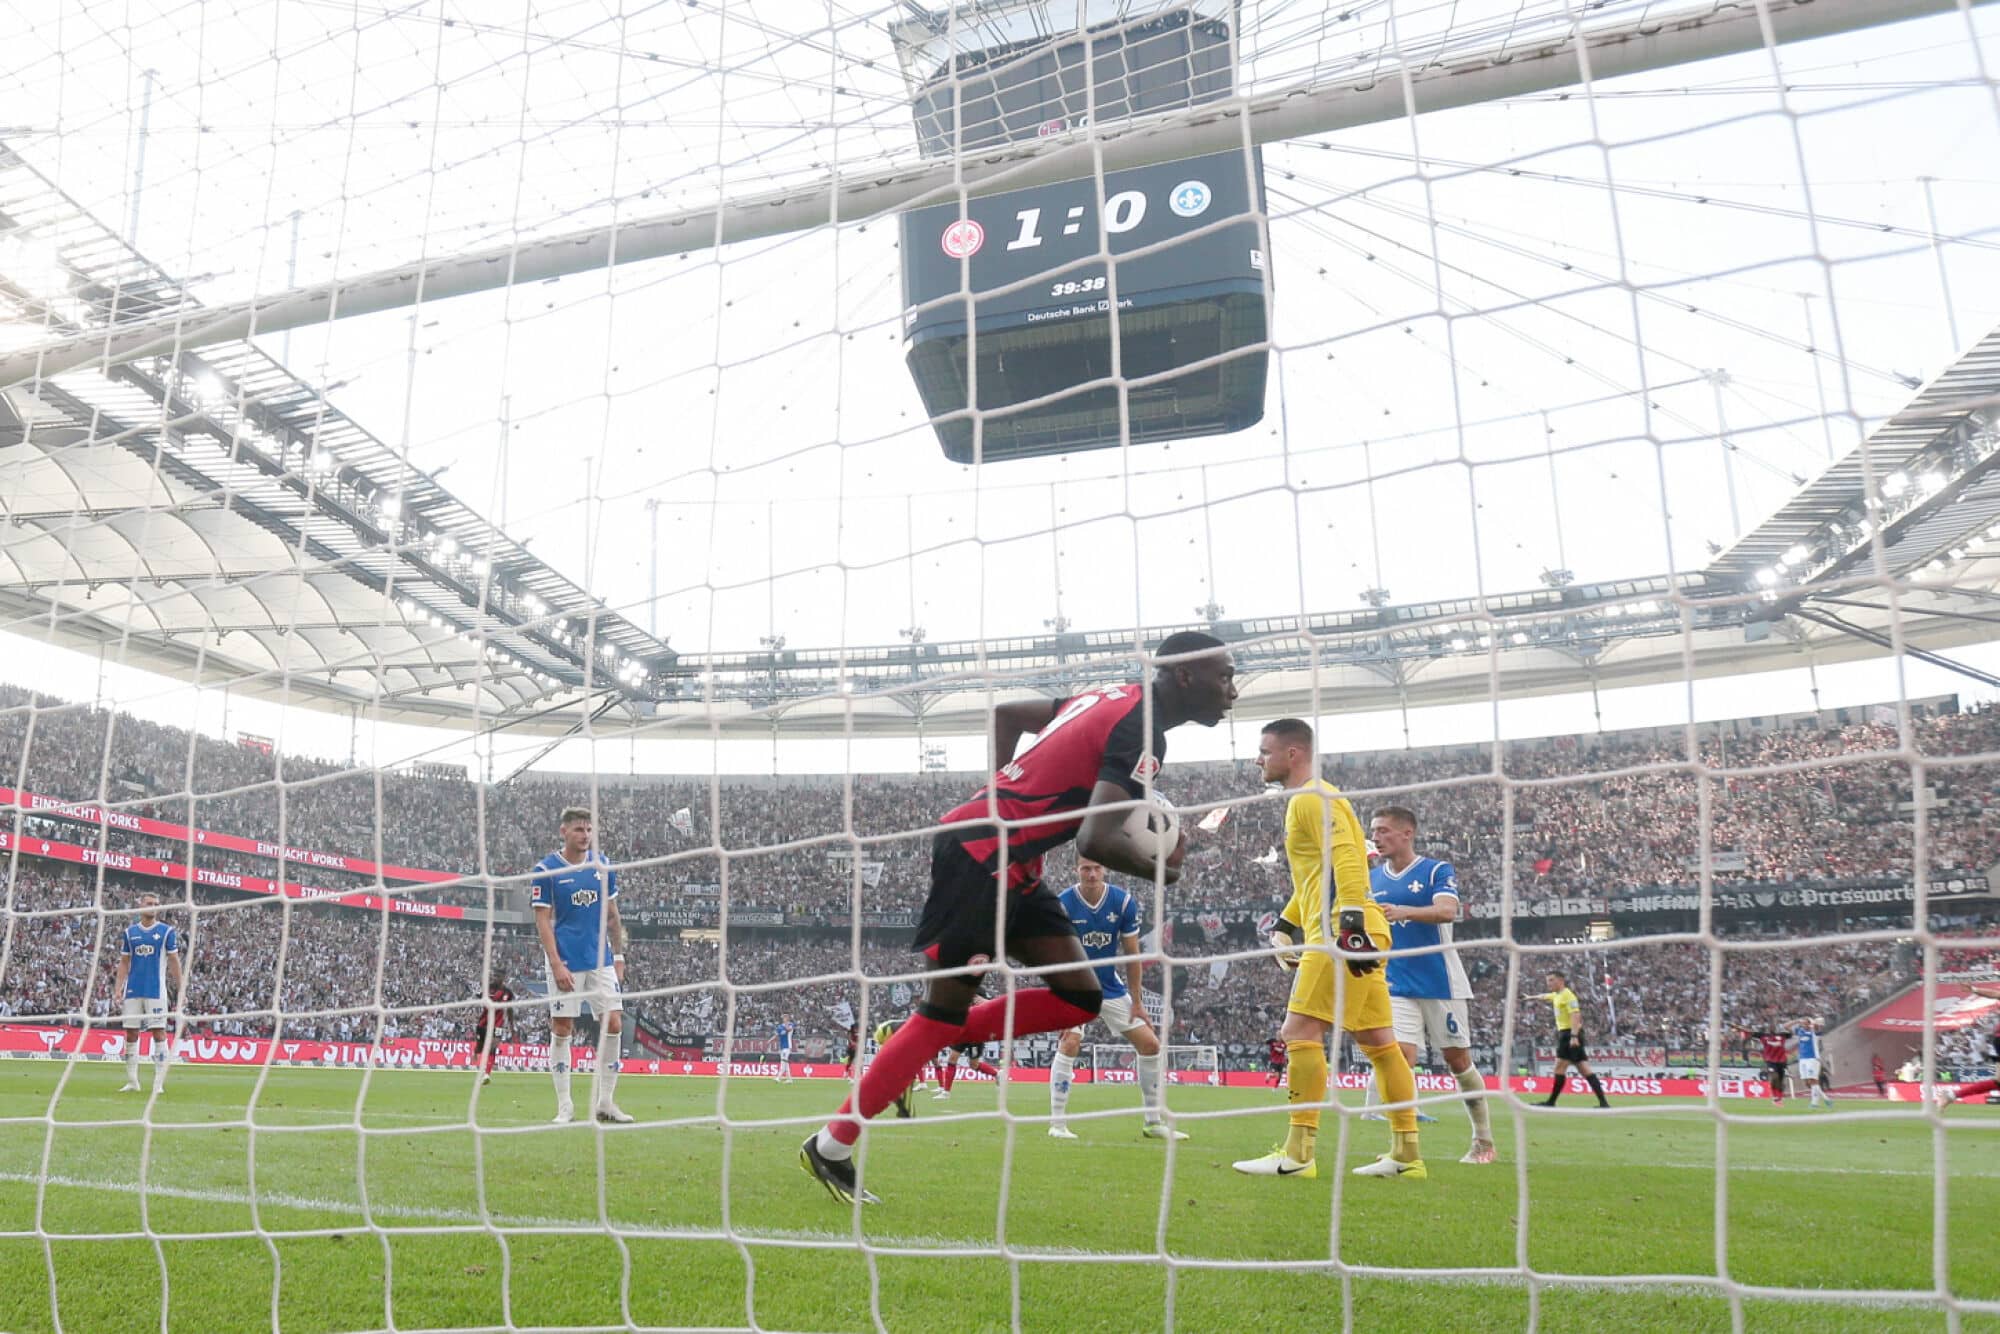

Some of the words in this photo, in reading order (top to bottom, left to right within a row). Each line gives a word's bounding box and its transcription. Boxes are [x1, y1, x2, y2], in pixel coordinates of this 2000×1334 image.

[1050, 276, 1107, 297] 39:38
[1027, 308, 1071, 322] Deutsche
[1072, 304, 1095, 315] Bank
[197, 870, 241, 887] STRAUSS
[395, 901, 437, 915] STRAUSS
[1446, 1011, 1459, 1034] 6
[1104, 1071, 1178, 1082] STRS
[1571, 1078, 1662, 1094] STRAUSS
